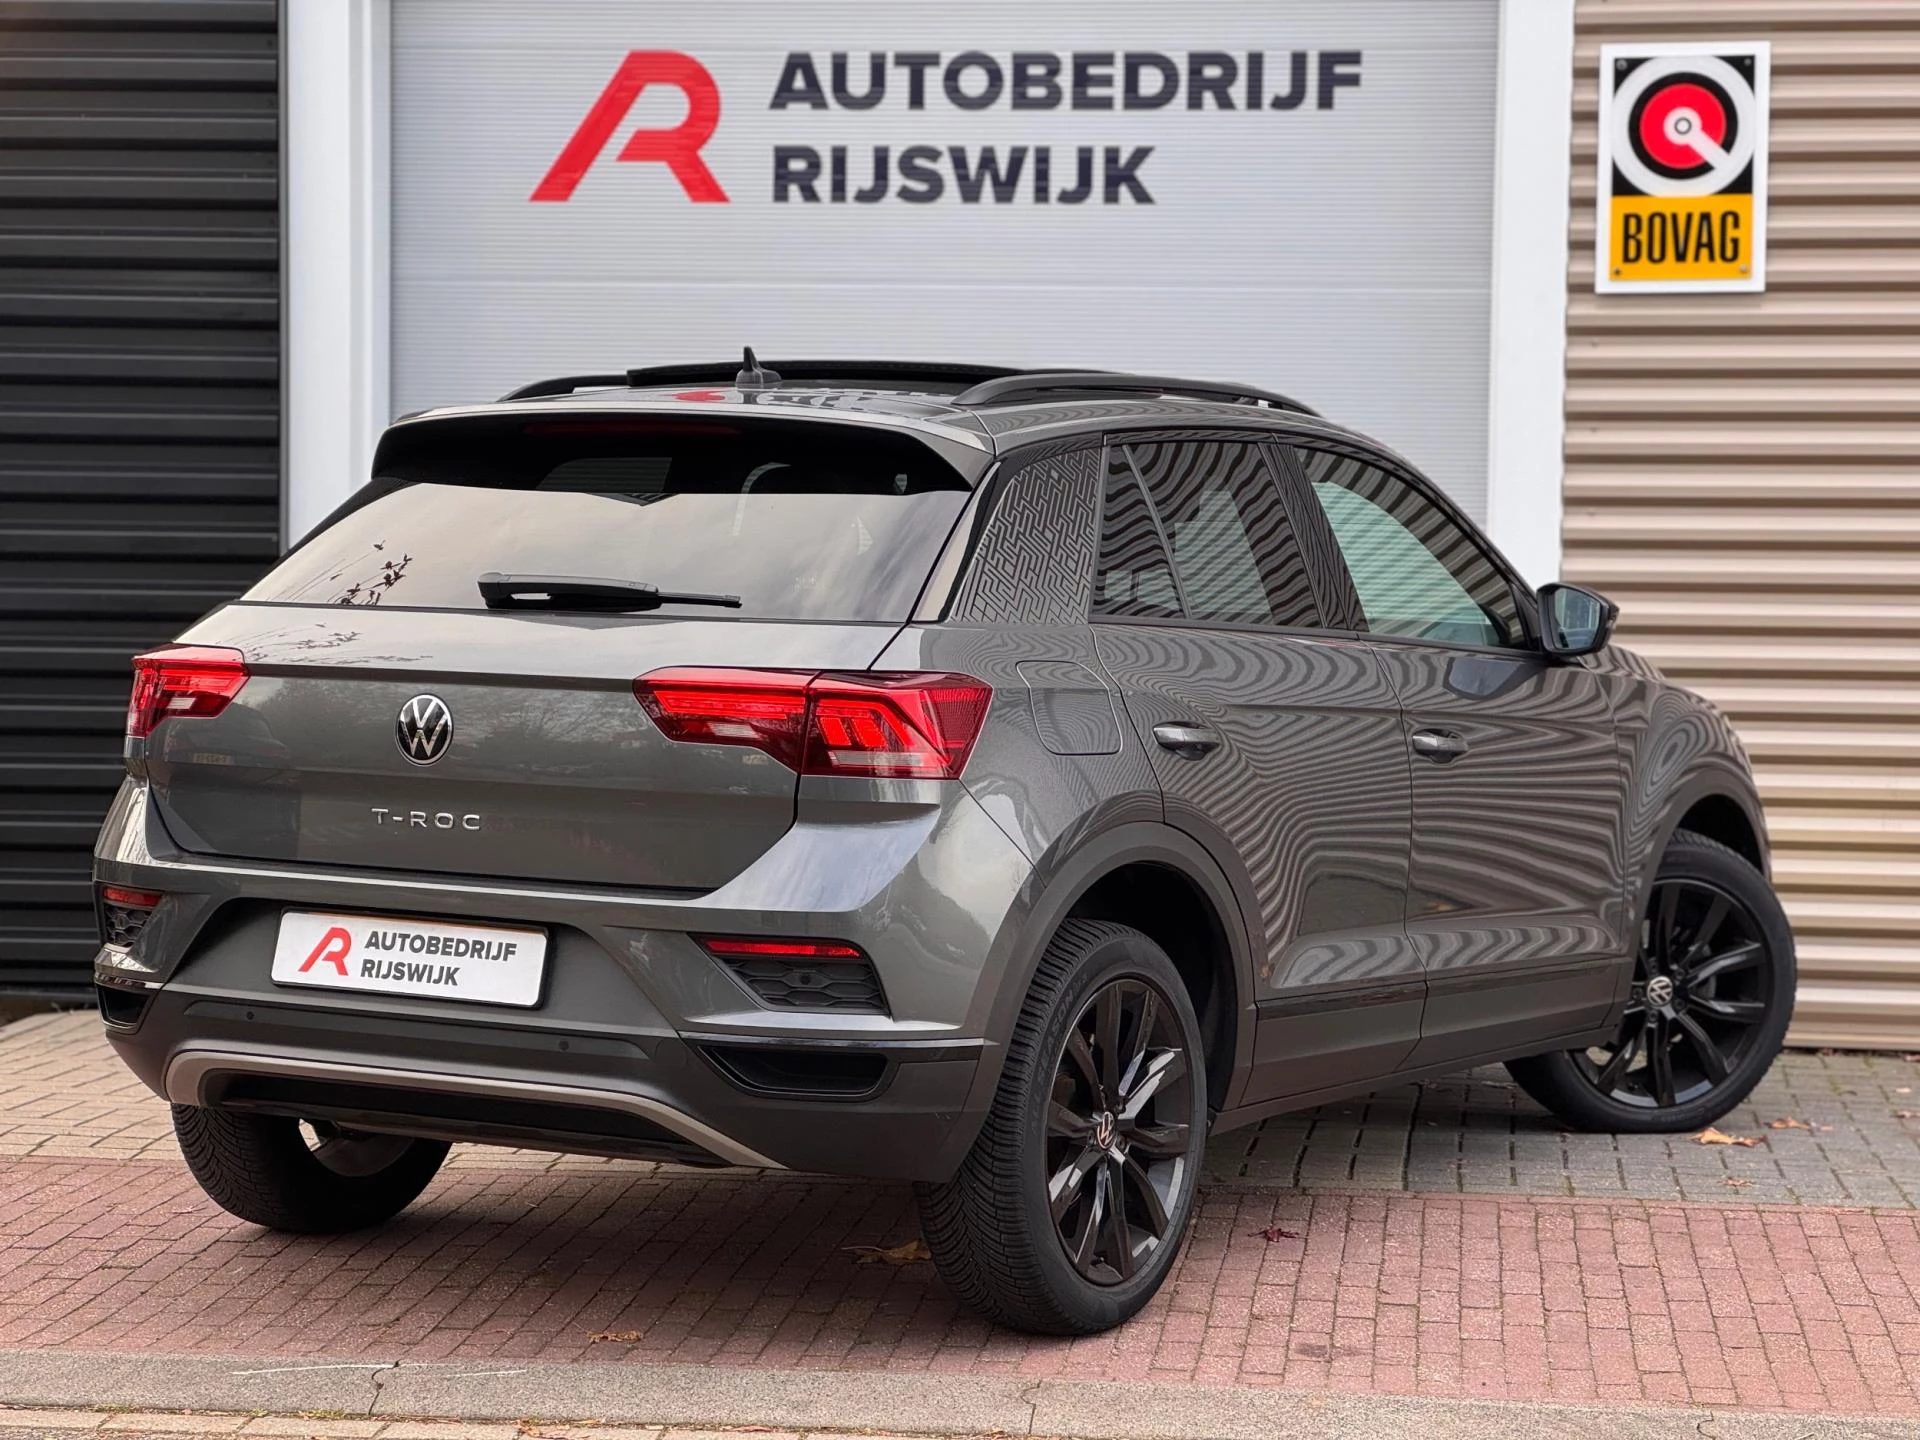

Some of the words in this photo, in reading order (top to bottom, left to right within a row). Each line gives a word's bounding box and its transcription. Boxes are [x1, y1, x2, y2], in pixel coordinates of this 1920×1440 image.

[770, 51, 1362, 110] AUTOBEDRIJF
[773, 146, 1155, 204] RIJSWIJK
[1622, 210, 1740, 264] BOVAG
[371, 808, 481, 831] T-ROC
[365, 931, 517, 962] AUTOBEDRIJF
[360, 959, 461, 986] RIJSWIJK
